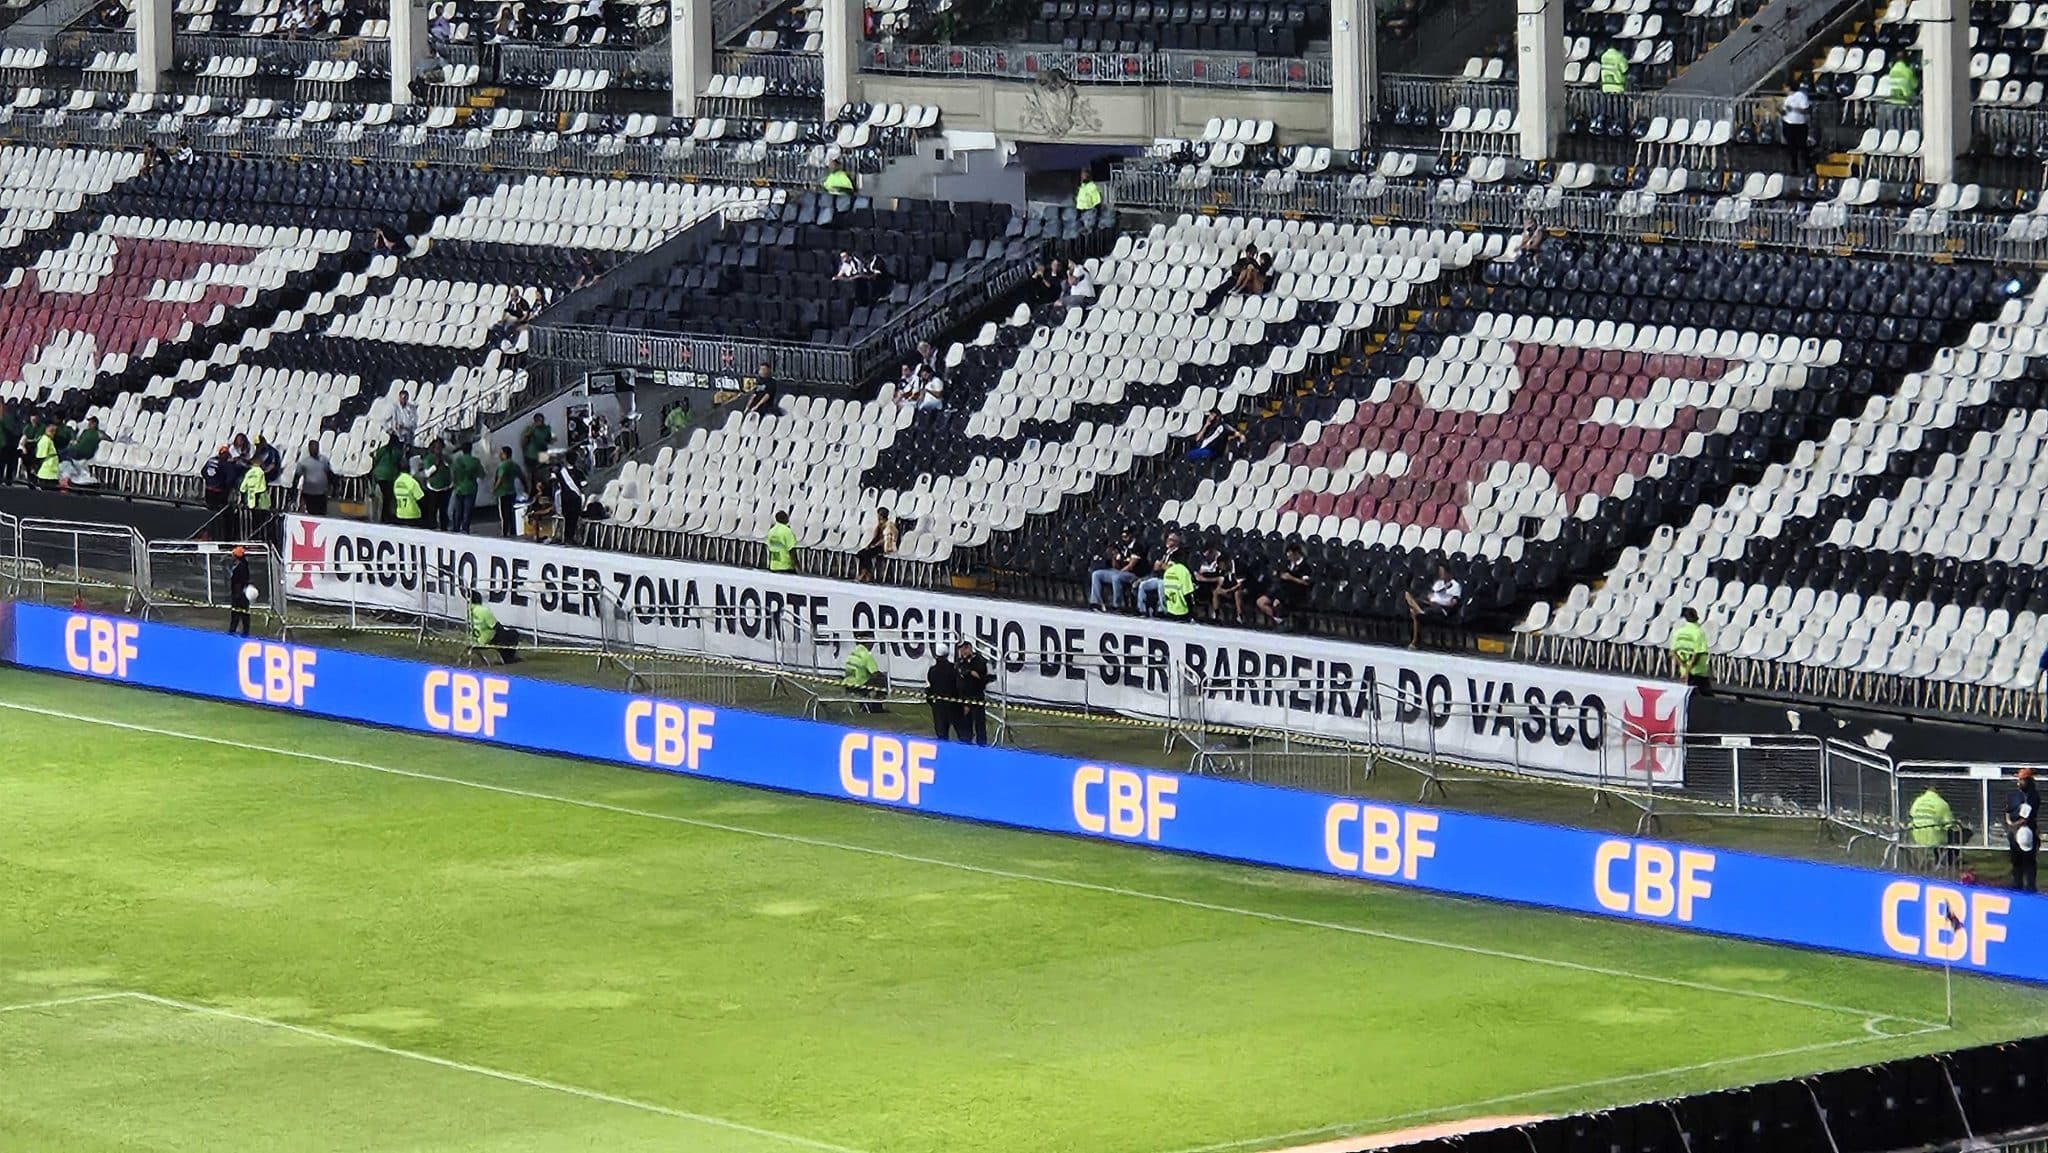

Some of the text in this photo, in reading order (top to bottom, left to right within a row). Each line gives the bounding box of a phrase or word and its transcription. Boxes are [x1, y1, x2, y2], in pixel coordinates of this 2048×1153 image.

[66, 616, 138, 676] CBF
[239, 642, 316, 705] CBF
[333, 535, 478, 597] ORGULHO
[488, 556, 530, 606] DE
[540, 562, 602, 617] SER
[612, 572, 701, 629] ZONA
[715, 584, 841, 659] NORTE,
[1039, 624, 1085, 681] DE
[1099, 632, 1170, 693] SER
[1185, 643, 1381, 722] BARREIRA
[1395, 668, 1452, 729] DO
[1467, 678, 1606, 751] VASCO
[424, 670, 509, 736] CBF
[625, 700, 715, 769] CBF
[840, 733, 936, 804] CBF
[1073, 766, 1178, 840] CBF
[1326, 803, 1438, 879] CBF
[1595, 840, 1715, 920] CBF
[1882, 882, 2009, 965] CBF
